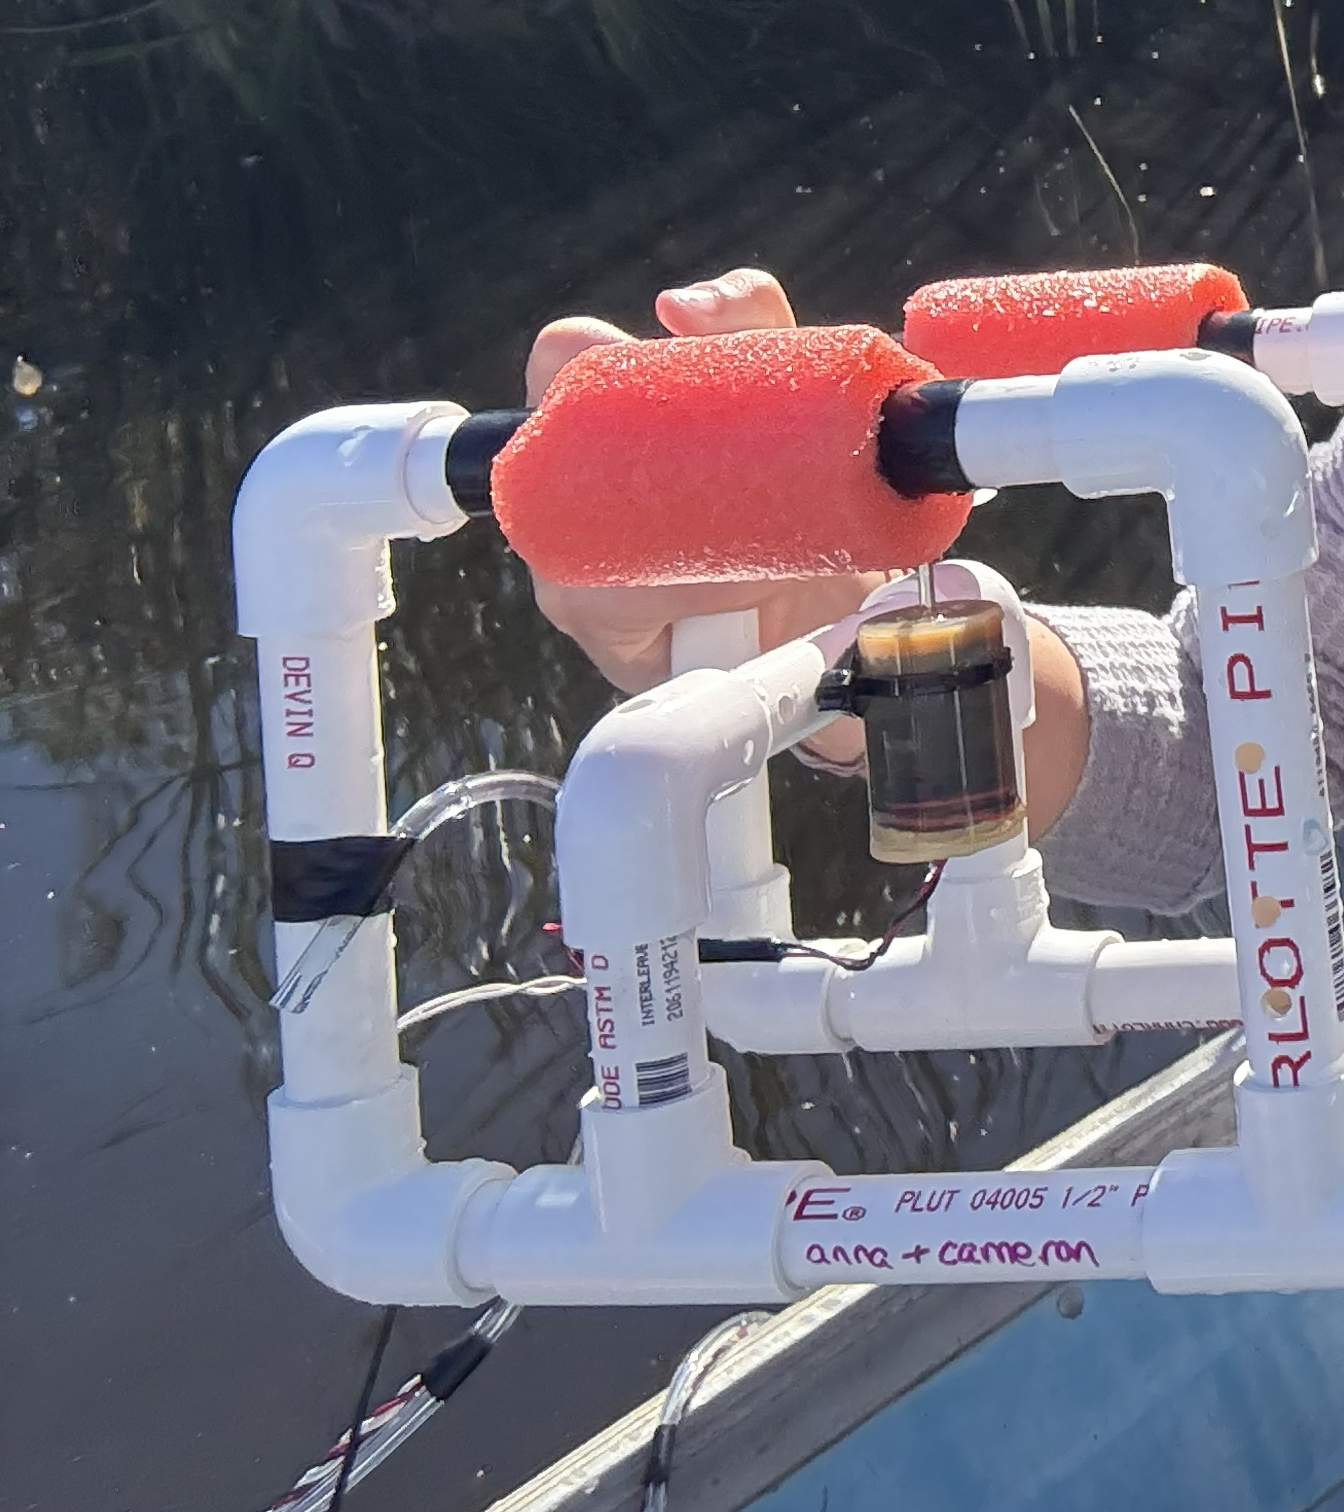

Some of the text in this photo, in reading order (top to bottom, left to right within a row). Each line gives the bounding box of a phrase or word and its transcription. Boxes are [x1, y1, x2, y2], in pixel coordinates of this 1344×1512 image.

[1220, 579, 1273, 701] PI
[282, 656, 316, 769] DEVIN Q
[591, 953, 610, 971] D
[594, 985, 617, 1050] ASTM
[894, 1189, 961, 1214] PLUT
[969, 1186, 1046, 1212] 04005
[1061, 1184, 1119, 1210] 1/2"
[805, 1238, 1101, 1270] anna + cameron
